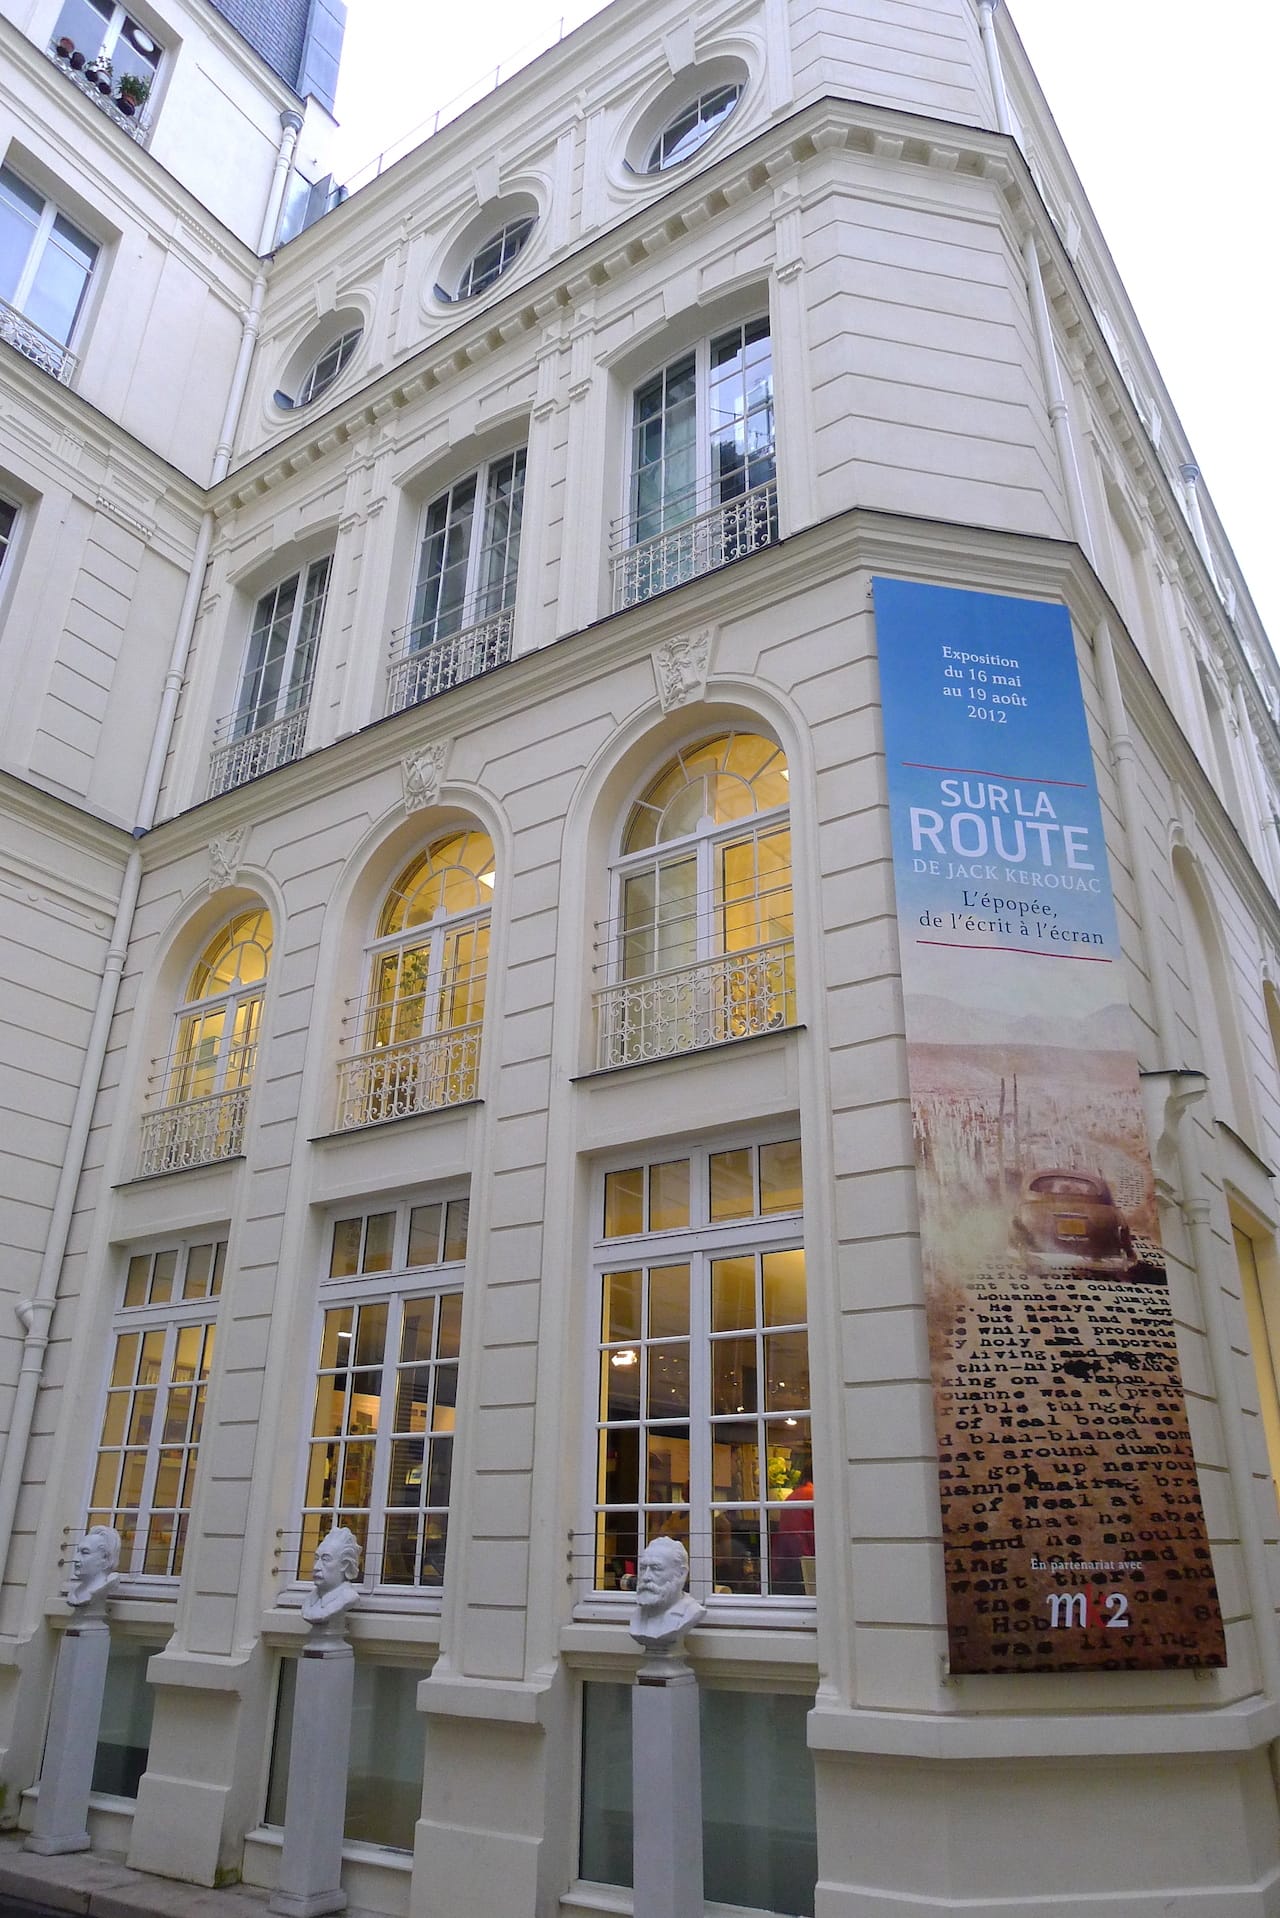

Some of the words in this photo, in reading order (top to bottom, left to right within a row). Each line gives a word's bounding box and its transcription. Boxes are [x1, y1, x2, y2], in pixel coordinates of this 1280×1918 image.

[942, 646, 1019, 669] Exposition
[944, 665, 963, 679] du
[969, 668, 987, 683] 16
[992, 675, 1021, 688] mai
[943, 686, 962, 697] au
[969, 687, 987, 701] 19
[992, 693, 1028, 707] août
[968, 705, 1007, 724] 2012
[940, 779, 1010, 814] SUR
[1014, 788, 1057, 819] LA
[910, 806, 1095, 871] ROUTE
[912, 858, 941, 876] DE
[946, 862, 999, 880] JACK
[1005, 868, 1101, 893] KEROUAC
[962, 890, 1058, 918] L'épopée,
[919, 910, 943, 928] de
[951, 913, 1012, 933] l'écrit
[1020, 920, 1029, 936] à
[1037, 922, 1104, 945] l'écran
[1009, 1282, 1031, 1291] to
[988, 1302, 1013, 1313] He
[976, 1313, 1014, 1323] but
[1010, 1376, 1040, 1385] on
[955, 1417, 983, 1430] of
[1003, 1443, 1099, 1460] around
[1052, 1462, 1087, 1475] up
[972, 1496, 1004, 1515] of
[1008, 1514, 1079, 1530] that
[1031, 1558, 1047, 1570] En
[1051, 1560, 1115, 1573] partenariat
[1120, 1561, 1143, 1570] avec
[1046, 1583, 1129, 1628] mk2
